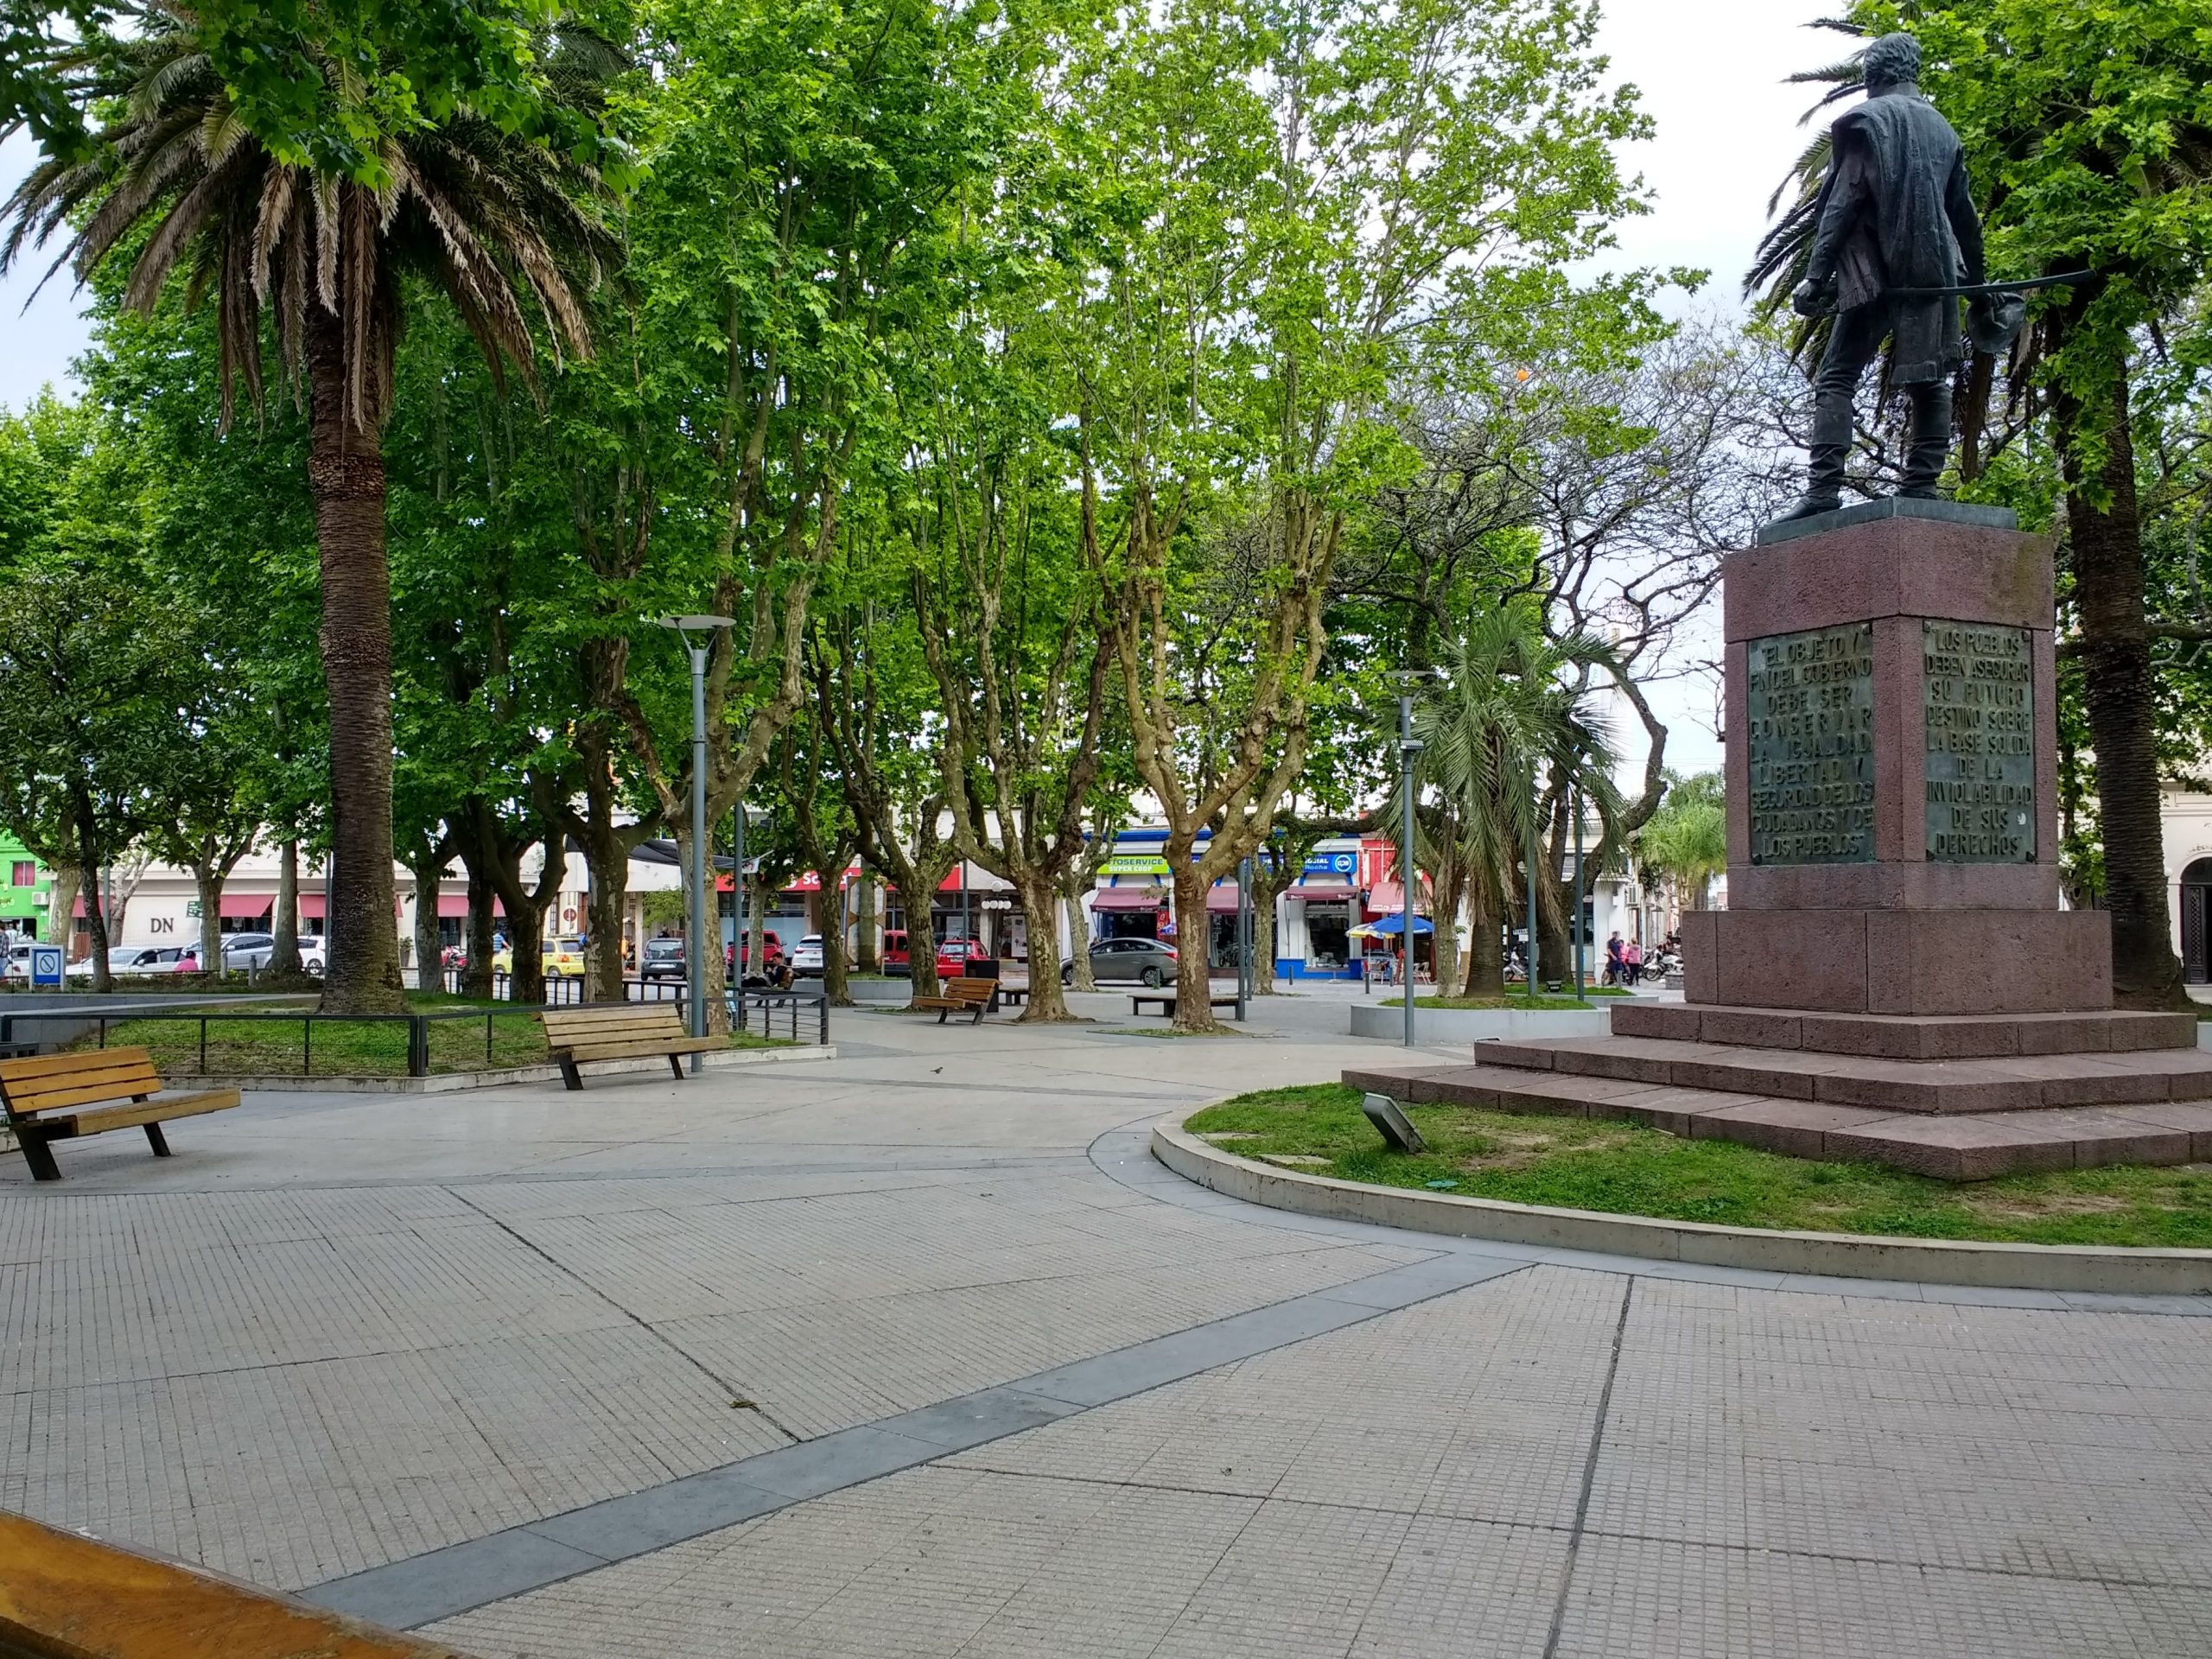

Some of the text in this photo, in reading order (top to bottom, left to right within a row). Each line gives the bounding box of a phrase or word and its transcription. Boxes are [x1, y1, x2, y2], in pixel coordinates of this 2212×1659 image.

[1787, 634, 1846, 664] OBJETO
[1751, 655, 1873, 693] FIN DEL GOBIERNO
[1925, 653, 2030, 683] DEBEN ASEGURAR
[1767, 685, 1854, 715] DEBE SER
[1931, 678, 2024, 707] SU FUTURO
[1750, 704, 1873, 740] CONSERVAR
[1925, 704, 2031, 732] DESTINO SOBRE
[1751, 741, 1770, 763] LA
[1926, 730, 2031, 757] LA BASE SOLIDA
[1759, 757, 1865, 787] LIBERTAD Y
[1957, 756, 2003, 779] DE LA
[1752, 781, 1874, 810] SEGURIDAD DE LOS
[1927, 780, 2031, 805] INVIOLABILIDAD
[1752, 805, 1874, 834] CIUDADANOS Y DE
[1951, 806, 2008, 830] DE SUS
[1763, 836, 1791, 858] LOS
[150, 918, 174, 933] DN
